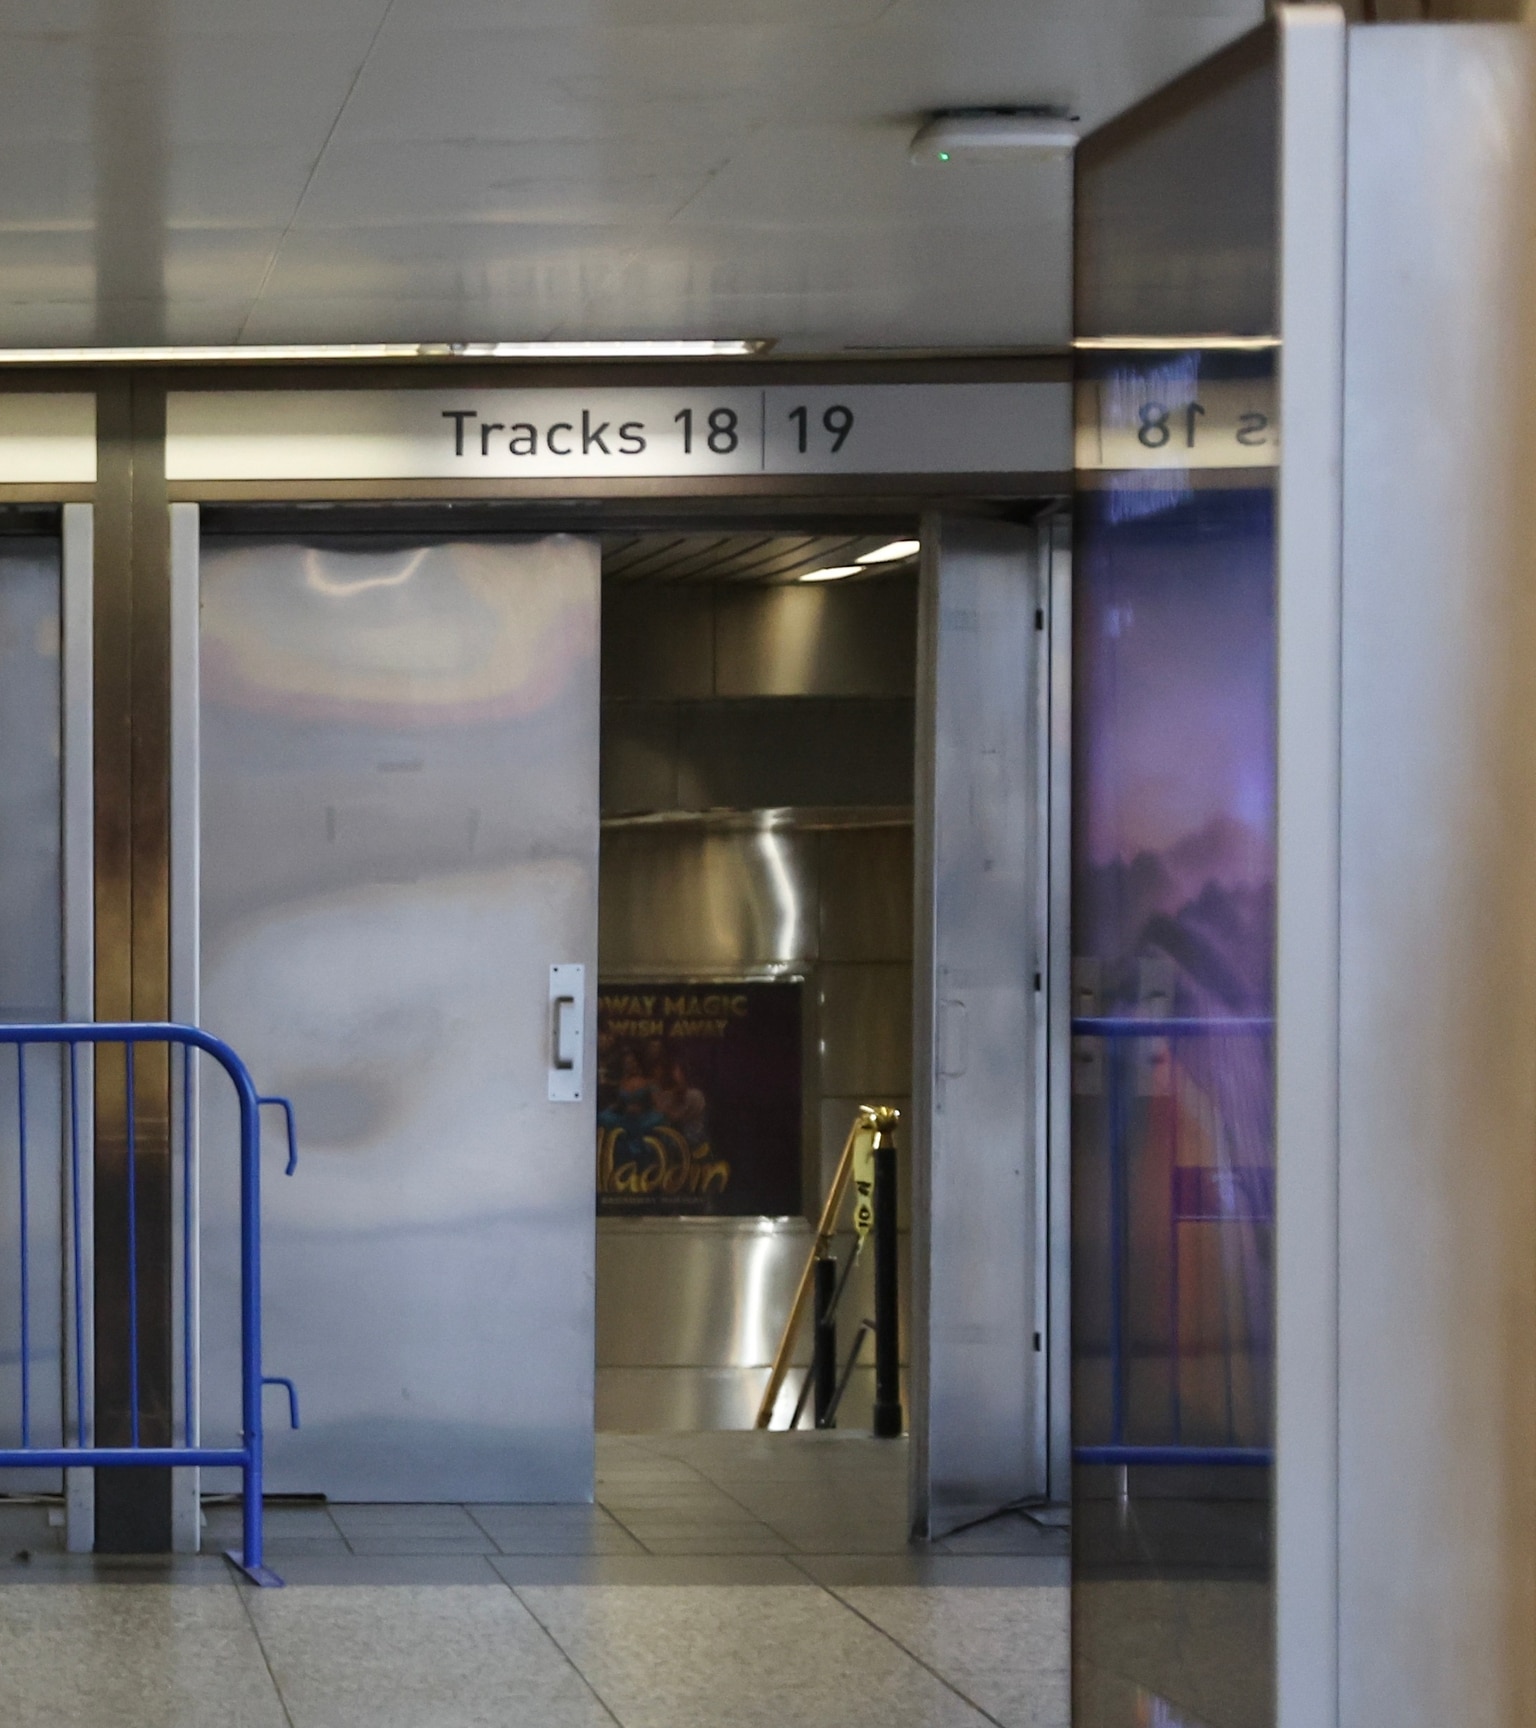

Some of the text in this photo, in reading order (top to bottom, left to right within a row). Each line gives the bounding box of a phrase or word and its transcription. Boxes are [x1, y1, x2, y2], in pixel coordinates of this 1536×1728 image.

[441, 405, 855, 457] Tracks 18 19
[598, 995, 748, 1017] WAY MAGIC
[608, 1019, 664, 1036] WISH
[597, 1126, 731, 1193] laddin
